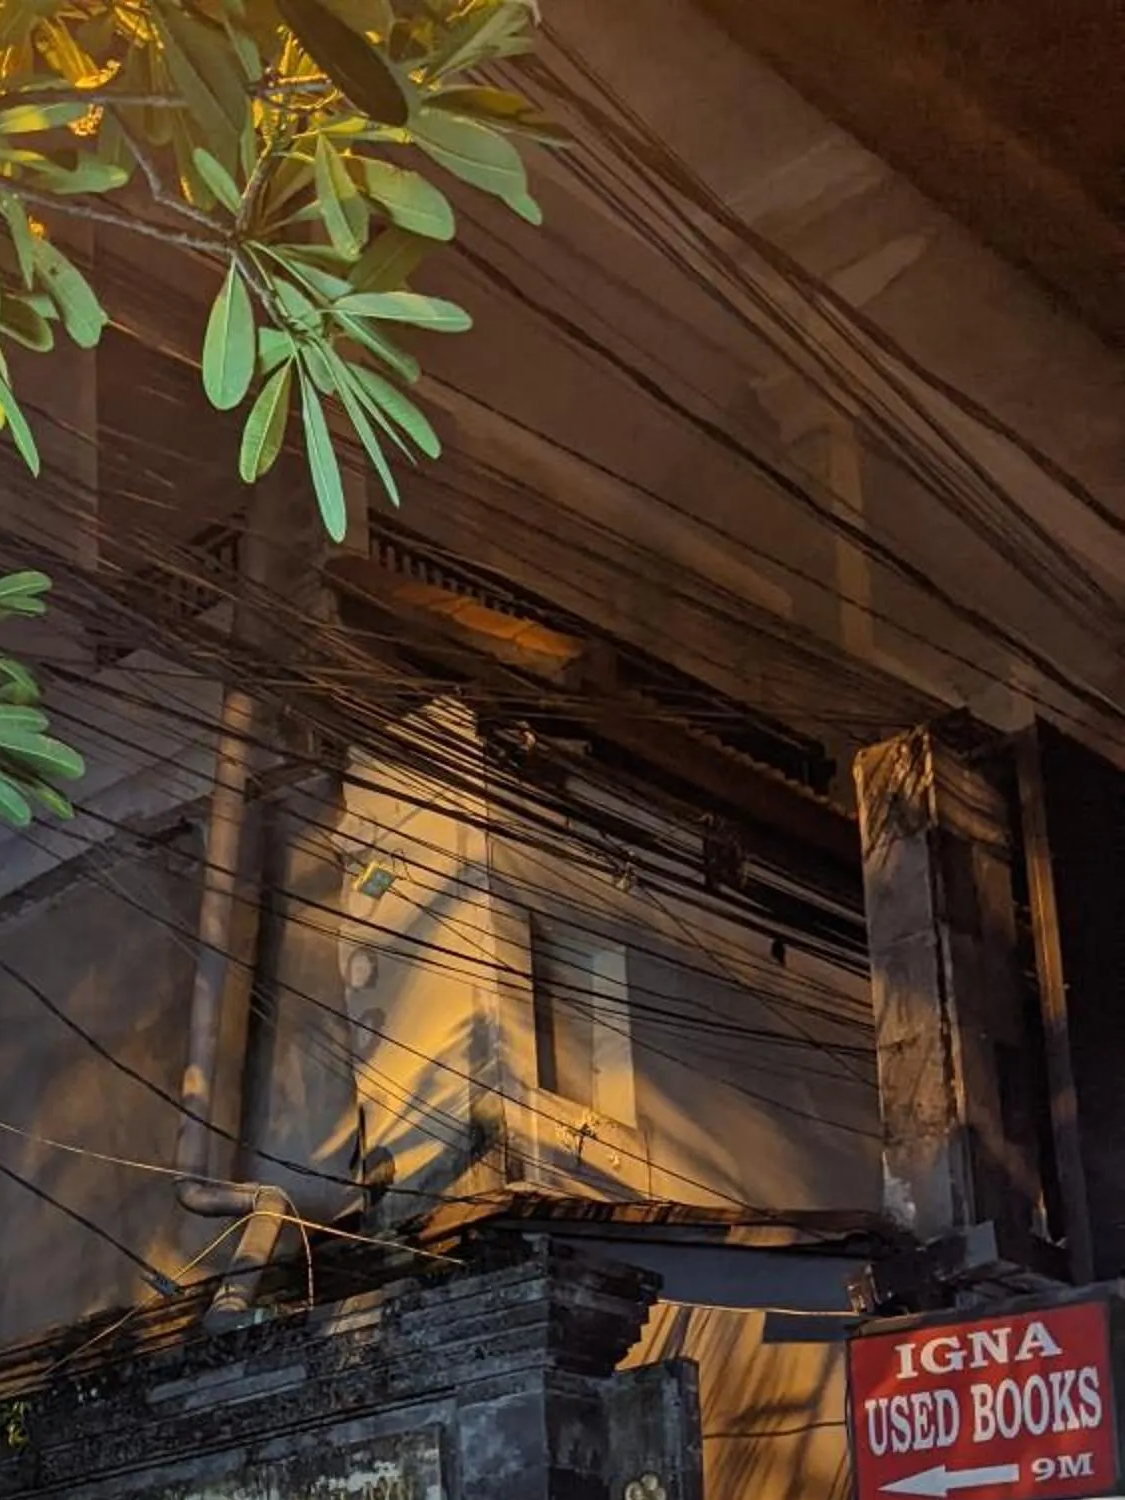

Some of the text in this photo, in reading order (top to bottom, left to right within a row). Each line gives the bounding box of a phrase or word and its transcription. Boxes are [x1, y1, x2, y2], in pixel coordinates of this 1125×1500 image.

[895, 1321, 1063, 1380] IGNA
[864, 1366, 1103, 1456] USED BOOKS
[1031, 1452, 1094, 1482] 9M
